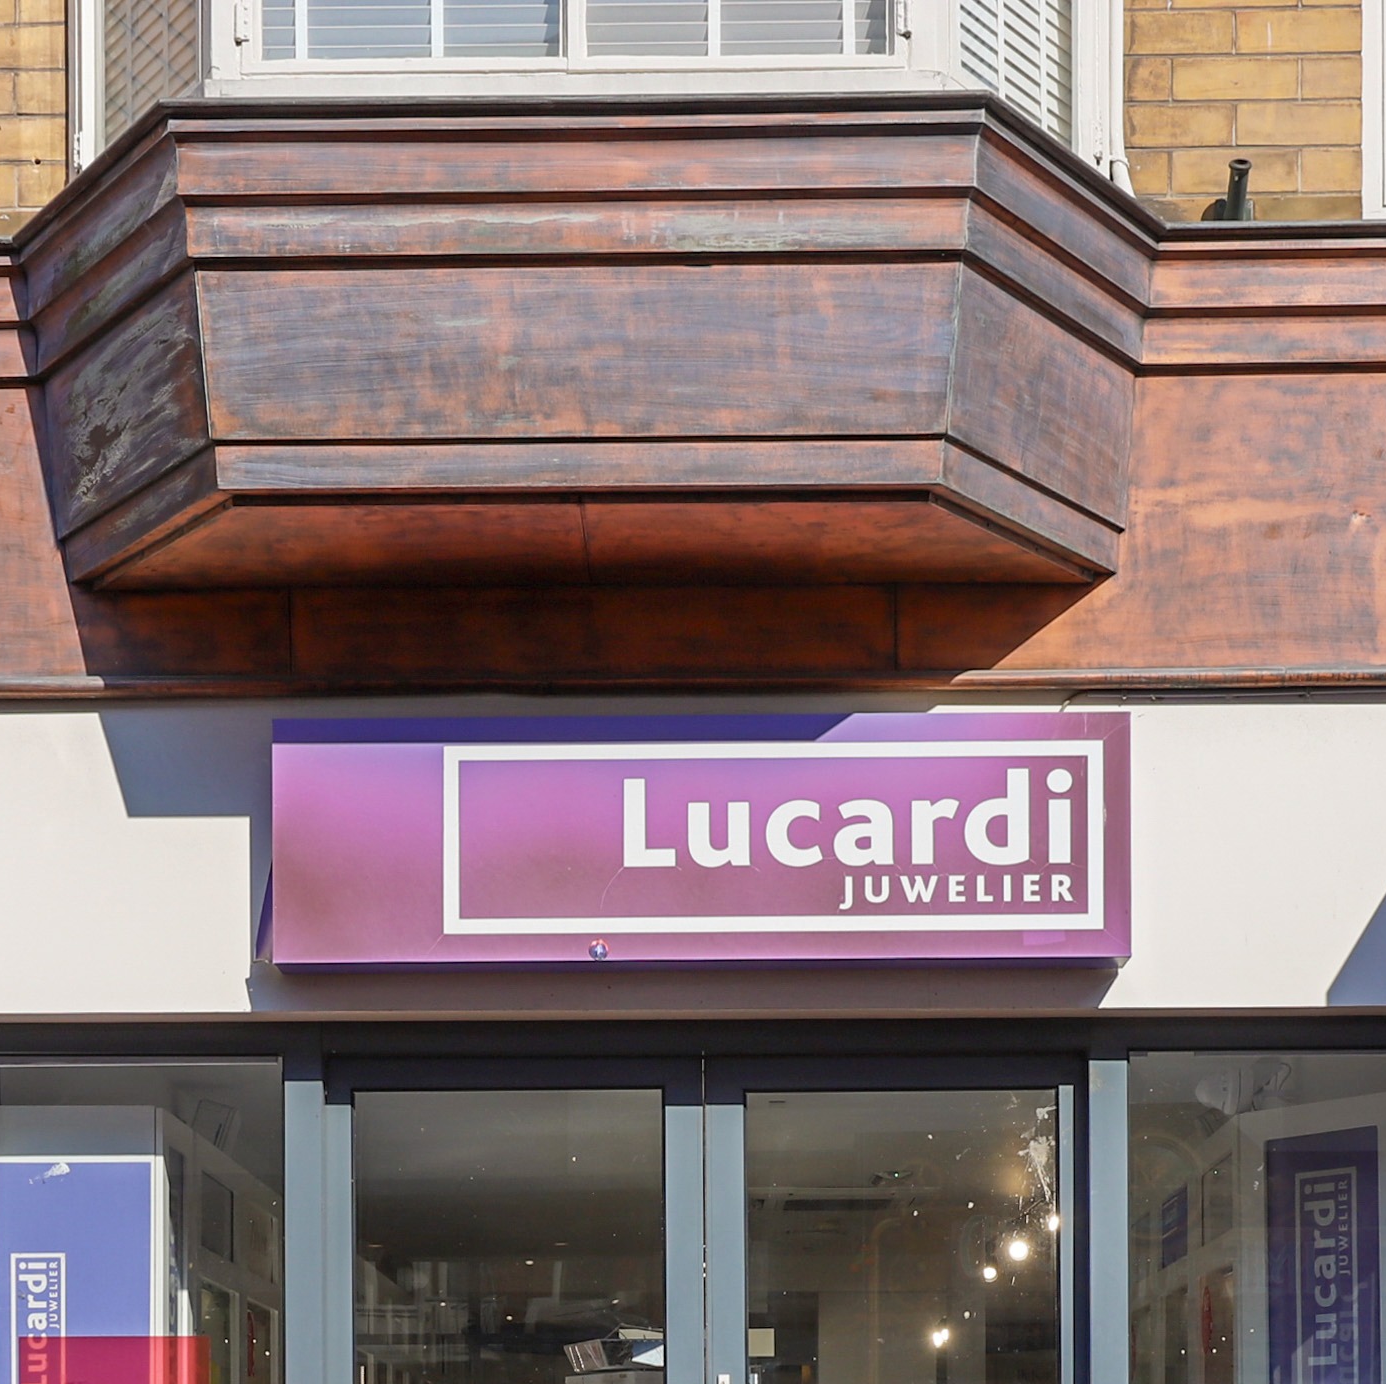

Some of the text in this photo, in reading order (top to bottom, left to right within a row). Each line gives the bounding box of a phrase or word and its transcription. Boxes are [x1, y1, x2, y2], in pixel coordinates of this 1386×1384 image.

[623, 767, 1073, 868] Lucardi
[838, 873, 1074, 910] JUWELIER
[1304, 1181, 1338, 1366] Lucardi
[1338, 1179, 1351, 1275] JUWELIER
[49, 1261, 60, 1328] JUWELIER
